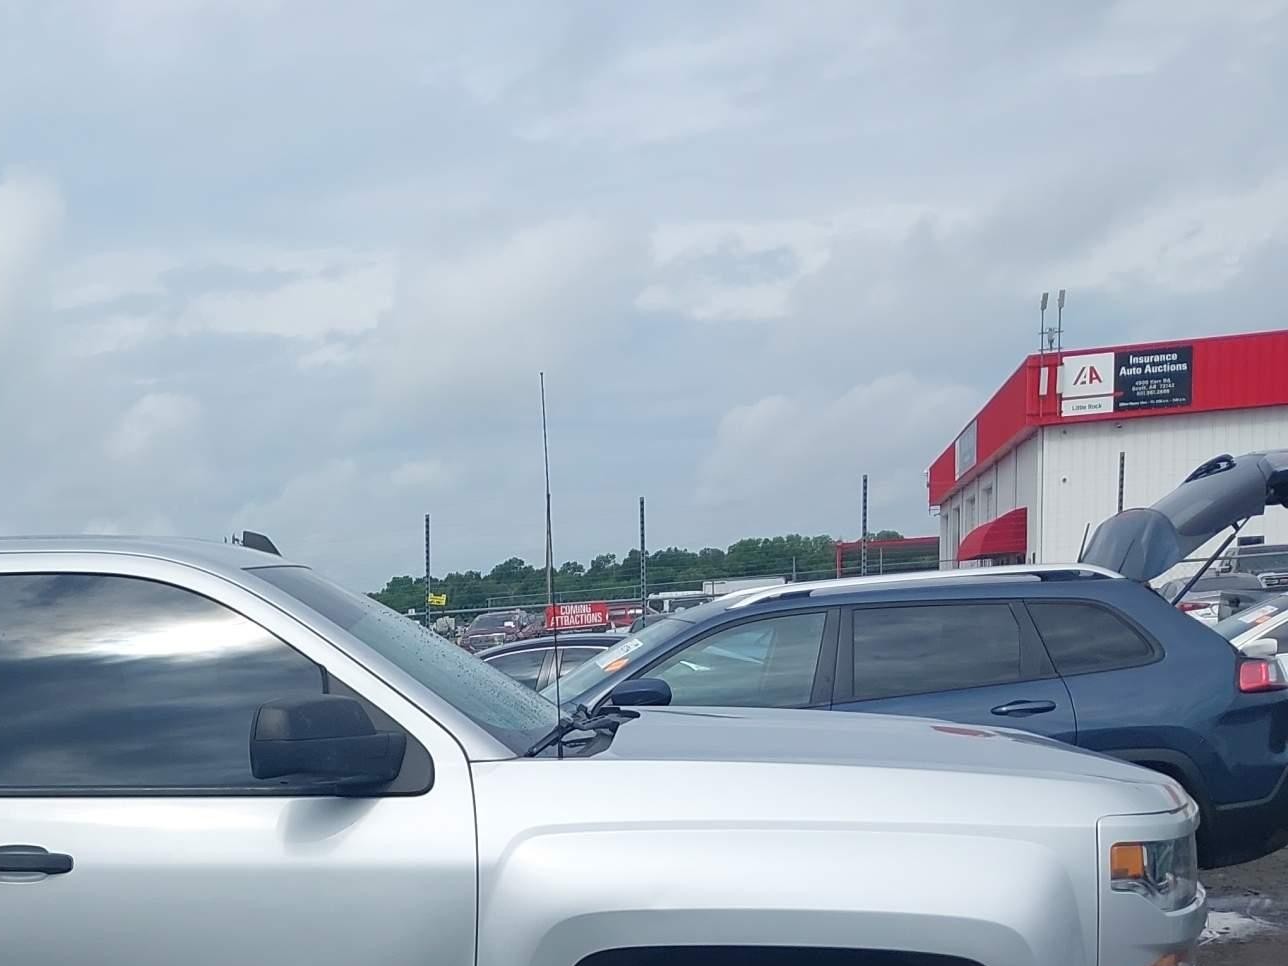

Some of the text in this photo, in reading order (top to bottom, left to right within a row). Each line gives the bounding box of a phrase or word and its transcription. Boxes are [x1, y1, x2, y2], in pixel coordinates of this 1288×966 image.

[1129, 353, 1178, 365] Insurance
[1119, 363, 1188, 376] Auto Auctions
[560, 604, 592, 615] COMING
[550, 612, 603, 627] ATTRACTIONS
